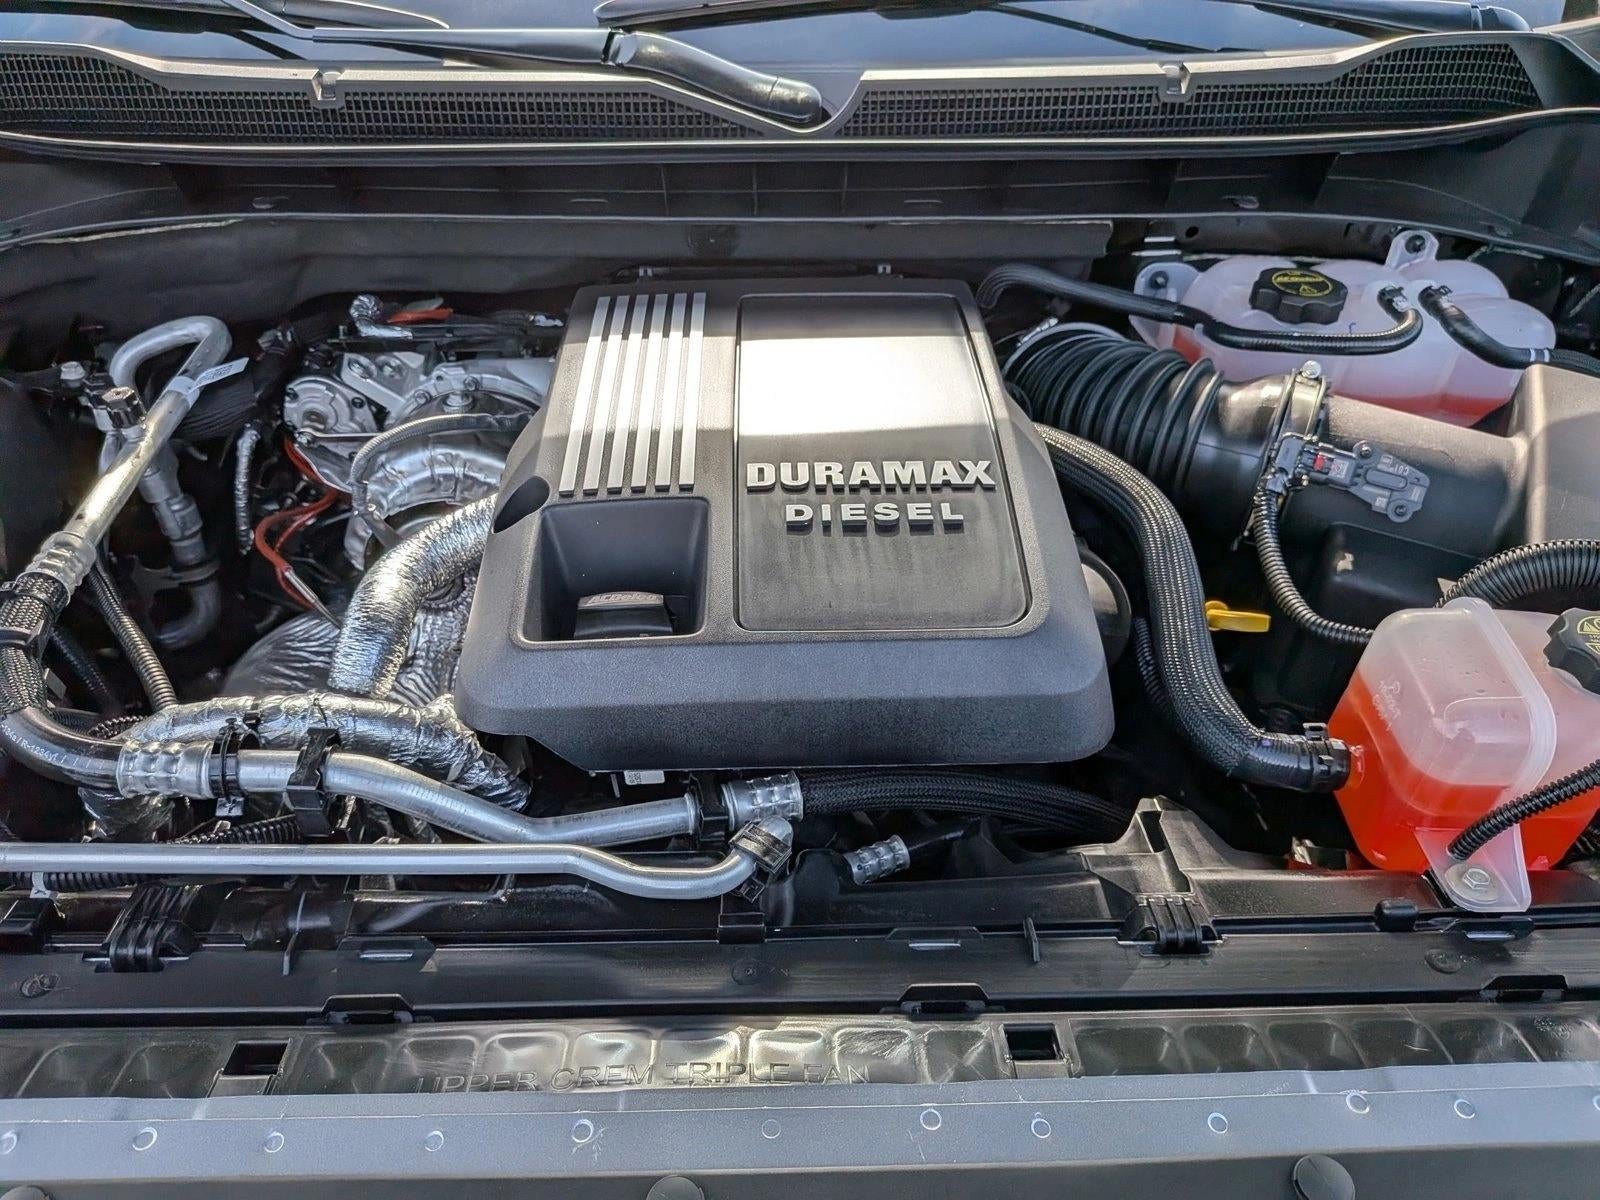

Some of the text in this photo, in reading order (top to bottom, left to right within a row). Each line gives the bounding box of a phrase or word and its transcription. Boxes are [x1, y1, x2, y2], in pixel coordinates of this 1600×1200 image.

[746, 460, 996, 490] DURAMAX
[785, 502, 964, 525] DIESEL
[665, 1061, 790, 1086] TRIPLE
[803, 1063, 870, 1085] FAN
